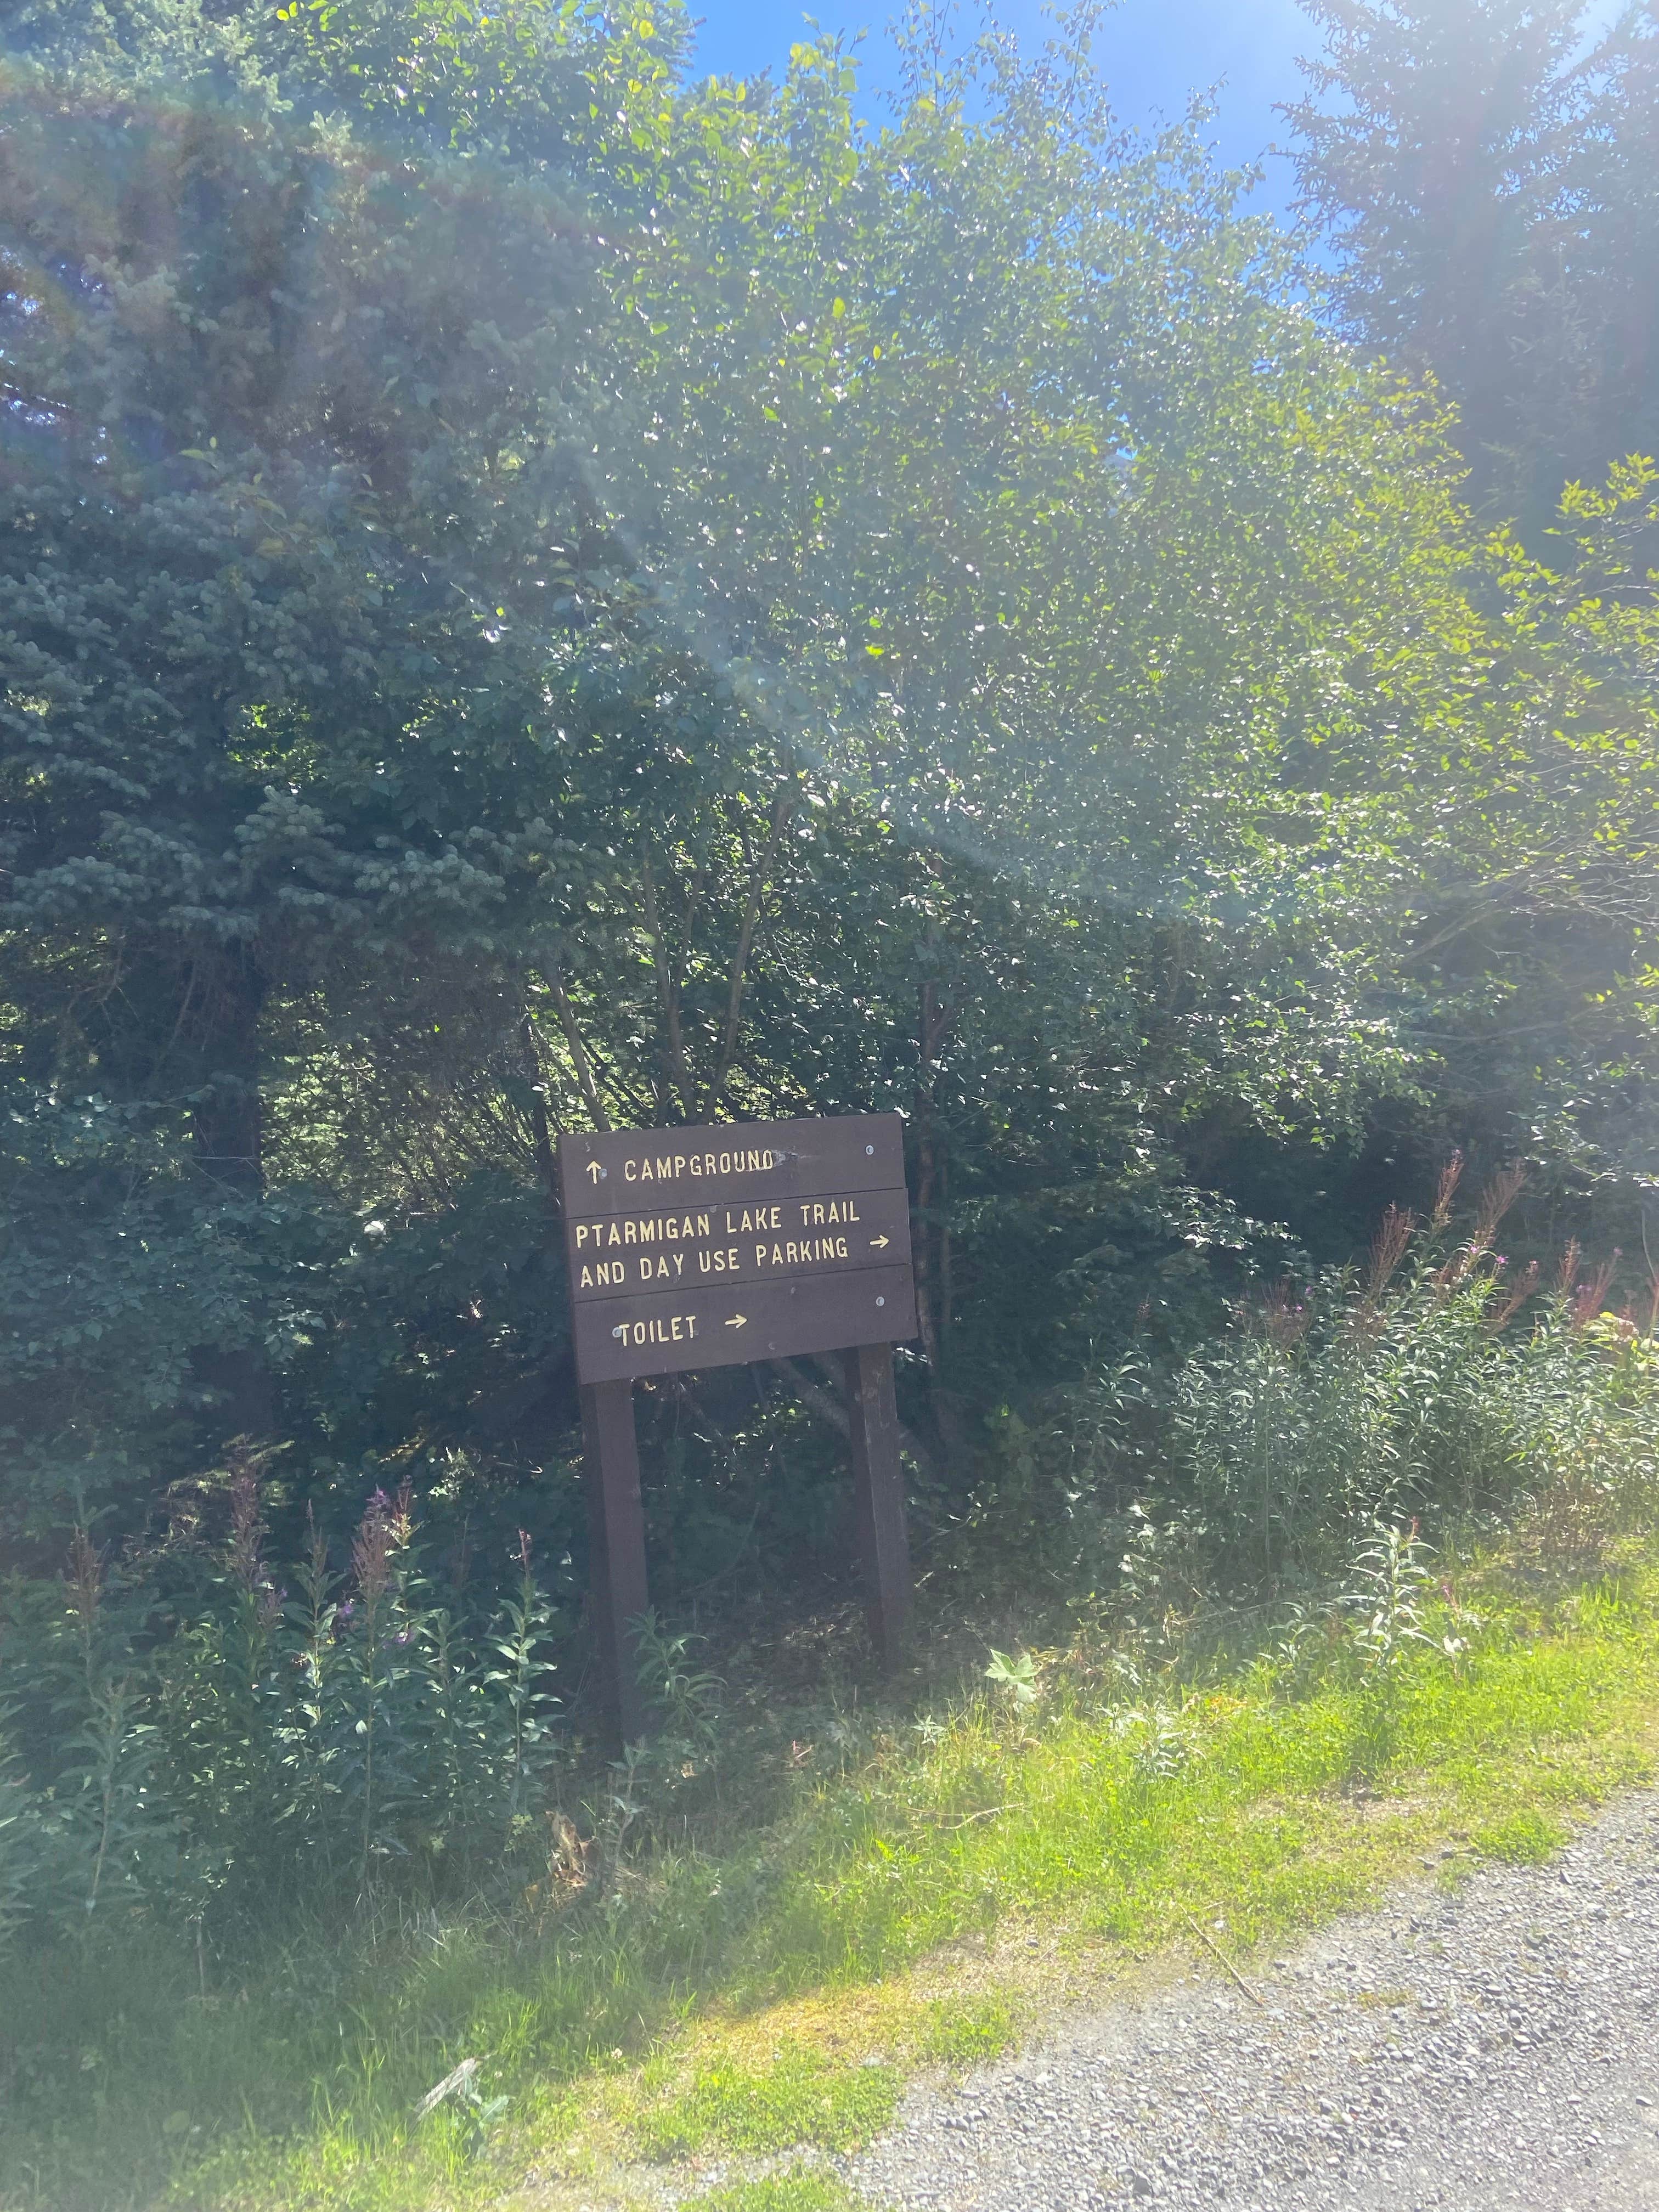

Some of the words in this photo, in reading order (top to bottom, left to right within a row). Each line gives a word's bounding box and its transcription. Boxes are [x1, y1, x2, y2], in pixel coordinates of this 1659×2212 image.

[624, 1149, 774, 1181] CAMPGROUND
[575, 1214, 710, 1249] PTARMIGAN
[726, 1206, 782, 1233] LAKE
[800, 1200, 860, 1226] TRAIL
[580, 1261, 625, 1288] AND
[640, 1253, 684, 1280] DAY
[698, 1248, 740, 1273] USE
[755, 1237, 848, 1267] PARKING
[618, 1315, 696, 1347] TOILET
